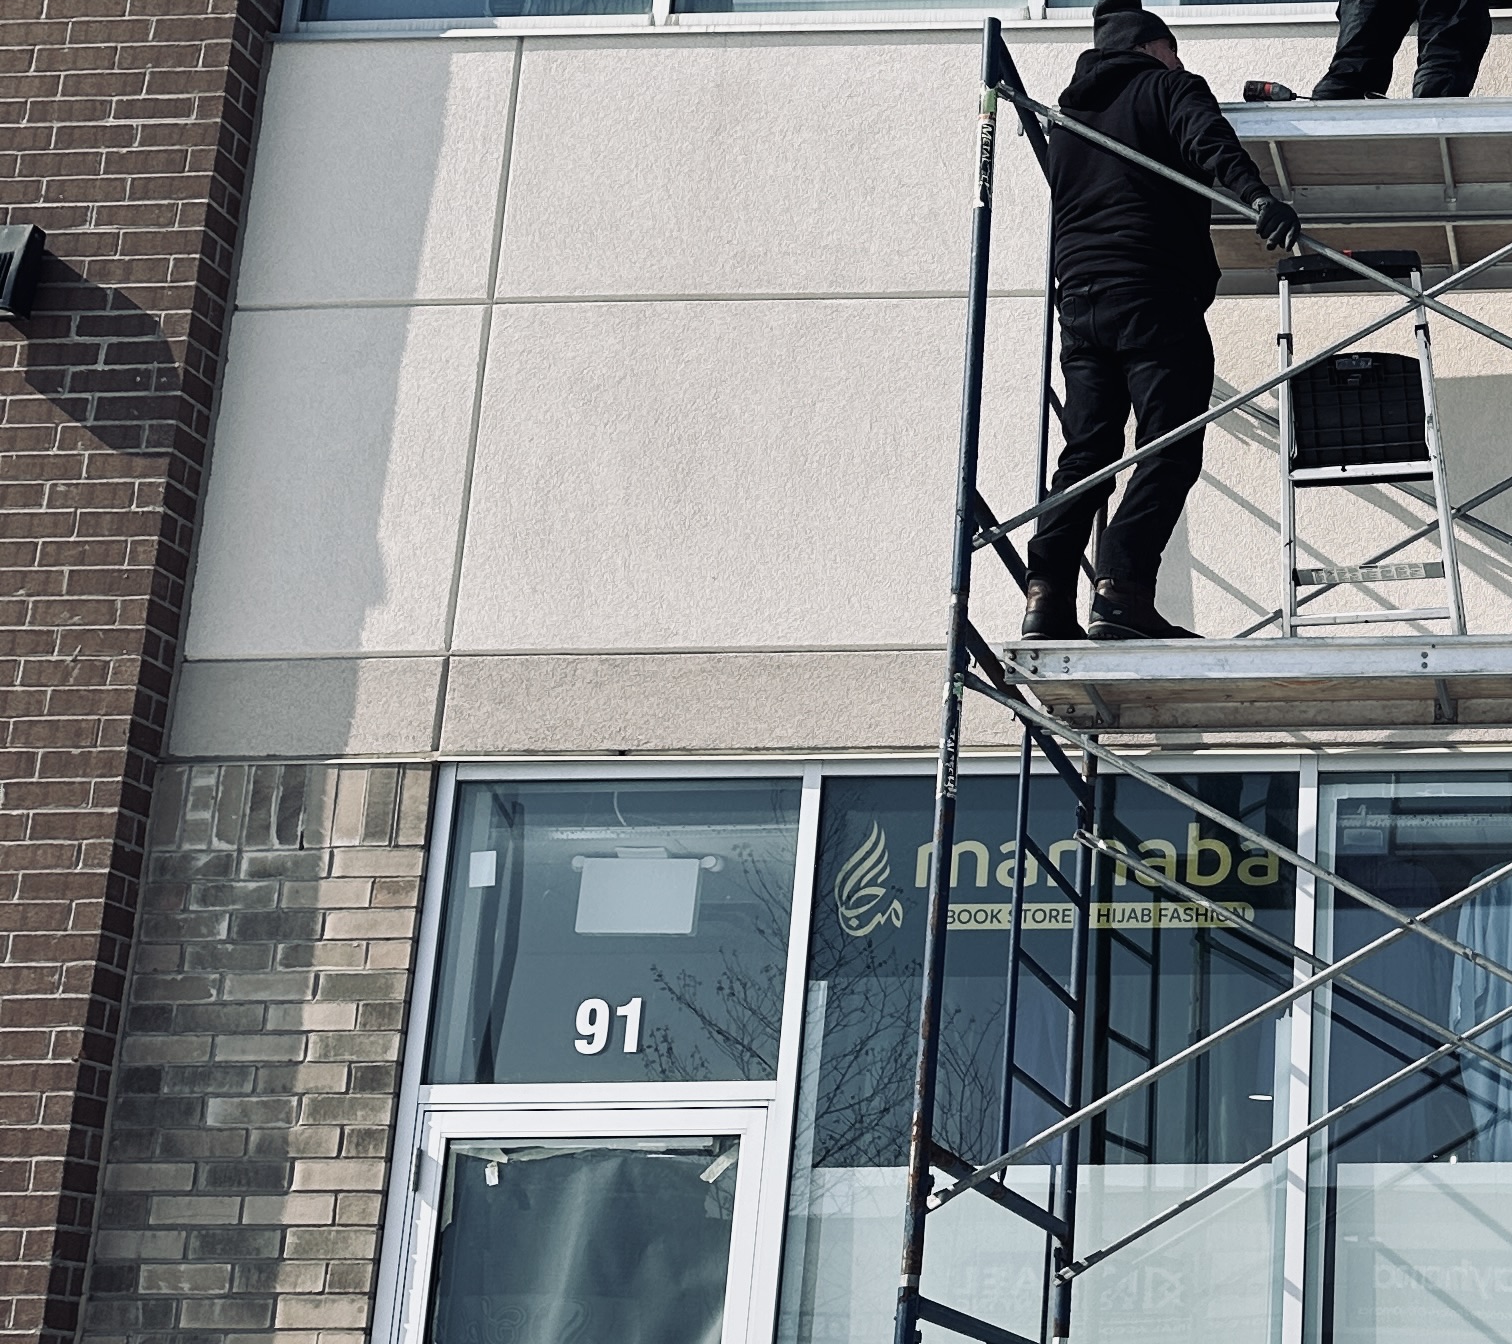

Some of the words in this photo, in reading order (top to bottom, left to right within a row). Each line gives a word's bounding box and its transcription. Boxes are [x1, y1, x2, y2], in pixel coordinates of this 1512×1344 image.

[947, 909, 1002, 925] BOOK
[1008, 908, 1073, 924] TORE
[1096, 907, 1153, 923] HIJAB
[574, 997, 643, 1056] 91
